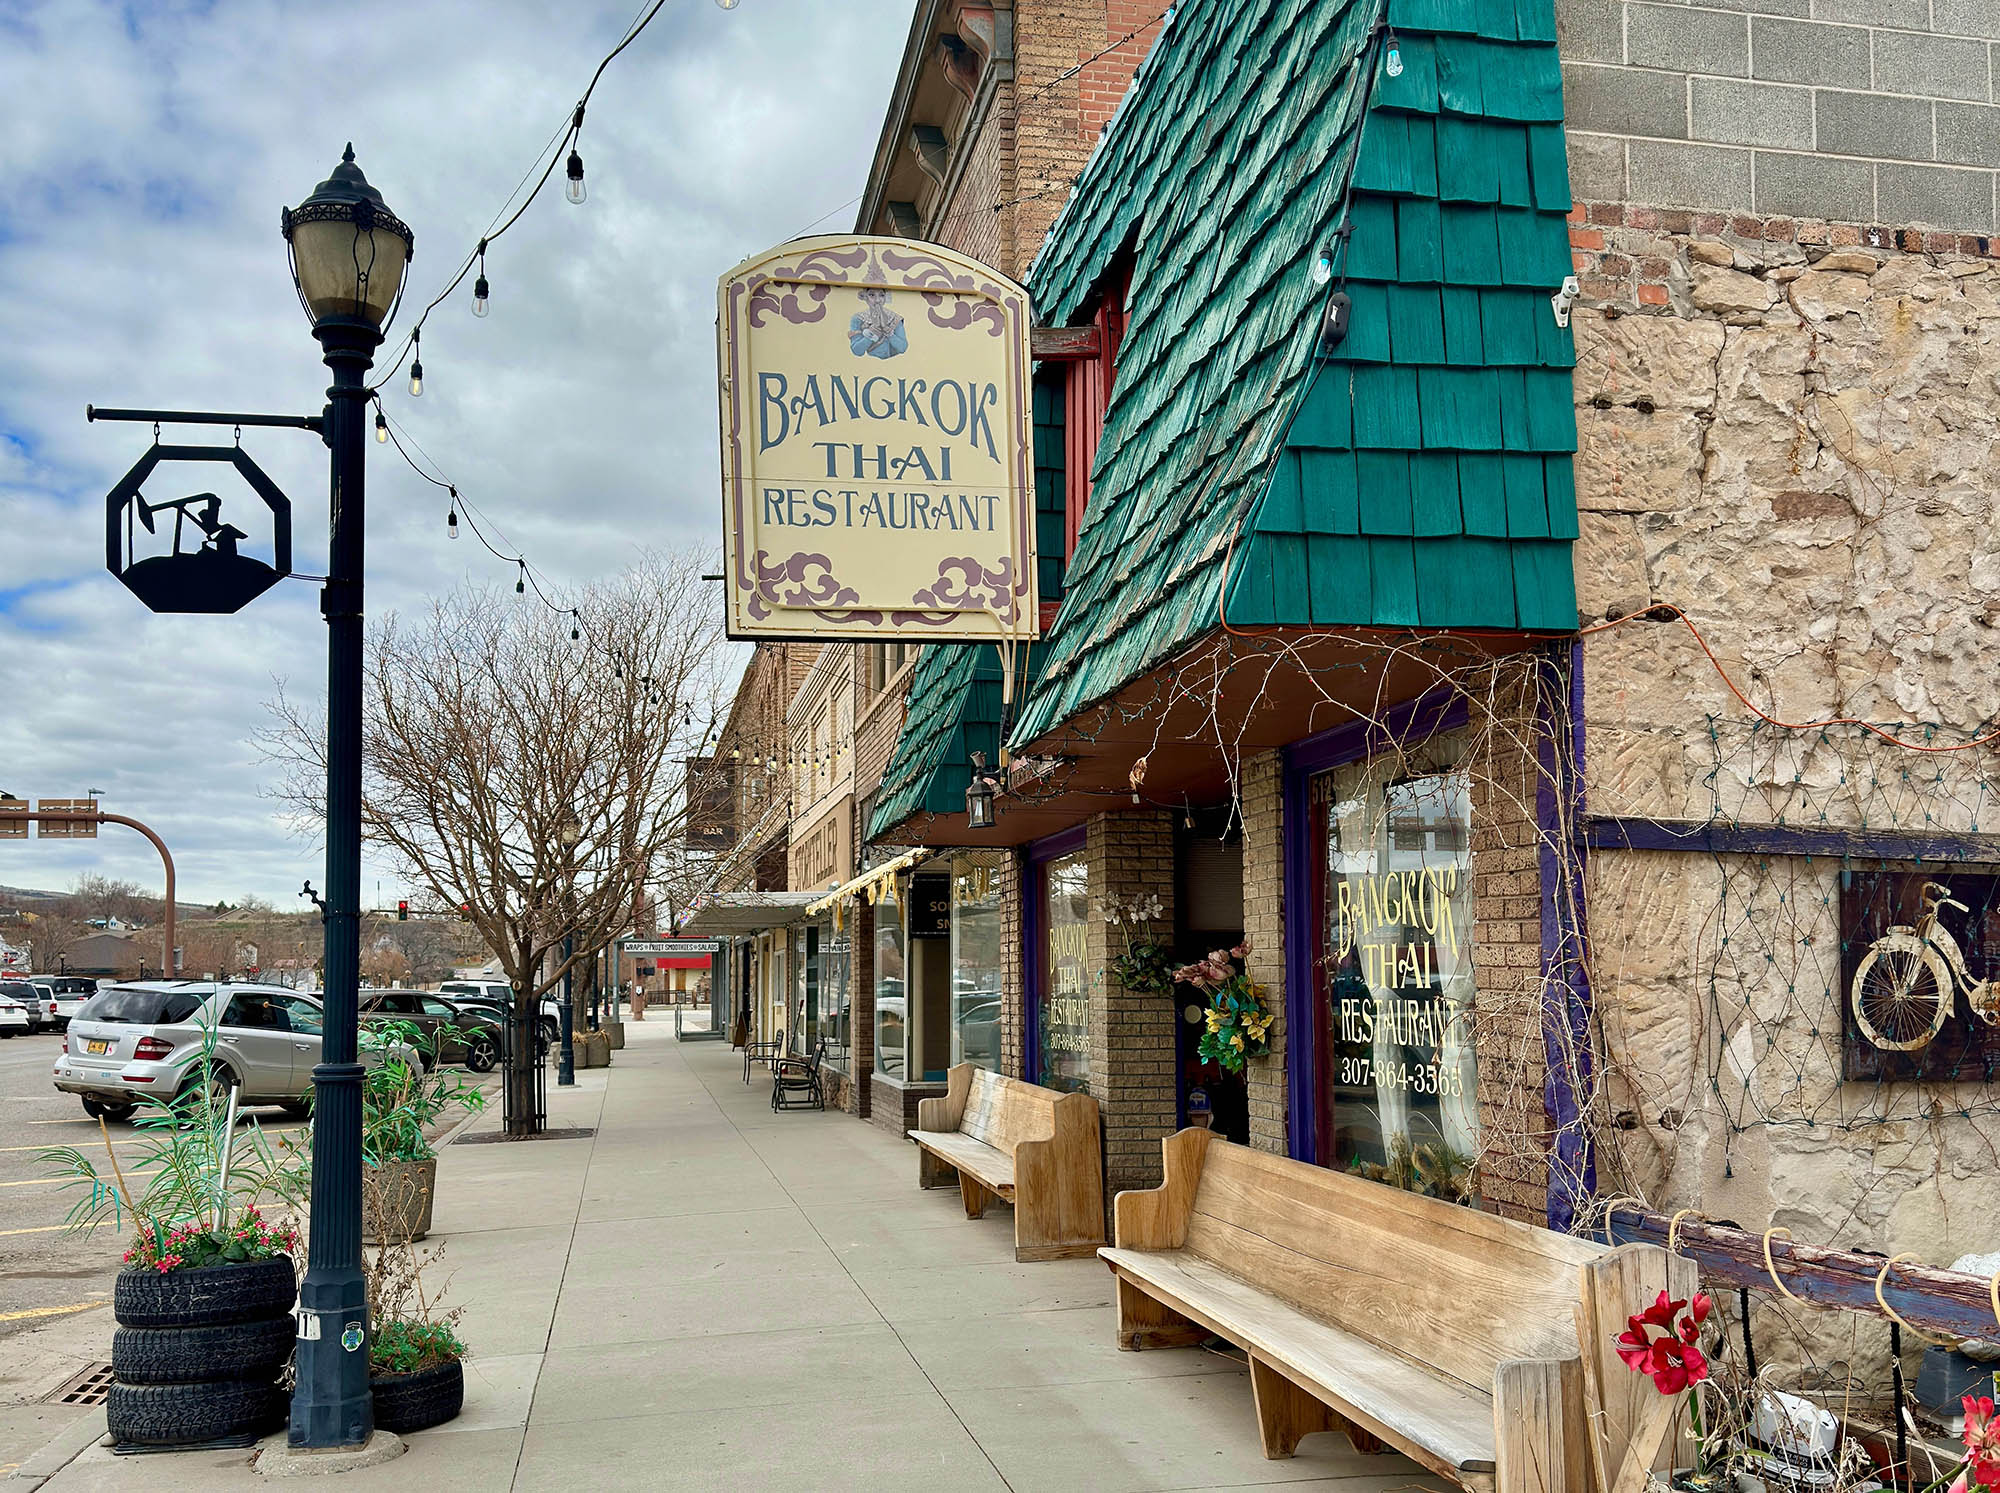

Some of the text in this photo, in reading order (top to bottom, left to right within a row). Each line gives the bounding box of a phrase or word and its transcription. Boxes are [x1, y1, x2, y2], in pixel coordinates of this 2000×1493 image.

[757, 371, 1001, 464] BANGKOK
[811, 442, 952, 481] THAI
[763, 488, 1000, 531] RESTAURANT
[703, 827, 723, 835] BAR
[1338, 863, 1459, 964] BANGKOK
[1050, 923, 1089, 976] BANGKOK
[1363, 941, 1432, 989] THAI
[1058, 967, 1081, 993] THAI
[1051, 998, 1089, 1027] RESTAURANT
[1341, 999, 1459, 1049] RESTAURANT
[1341, 1057, 1463, 1097] 307-864-3565
